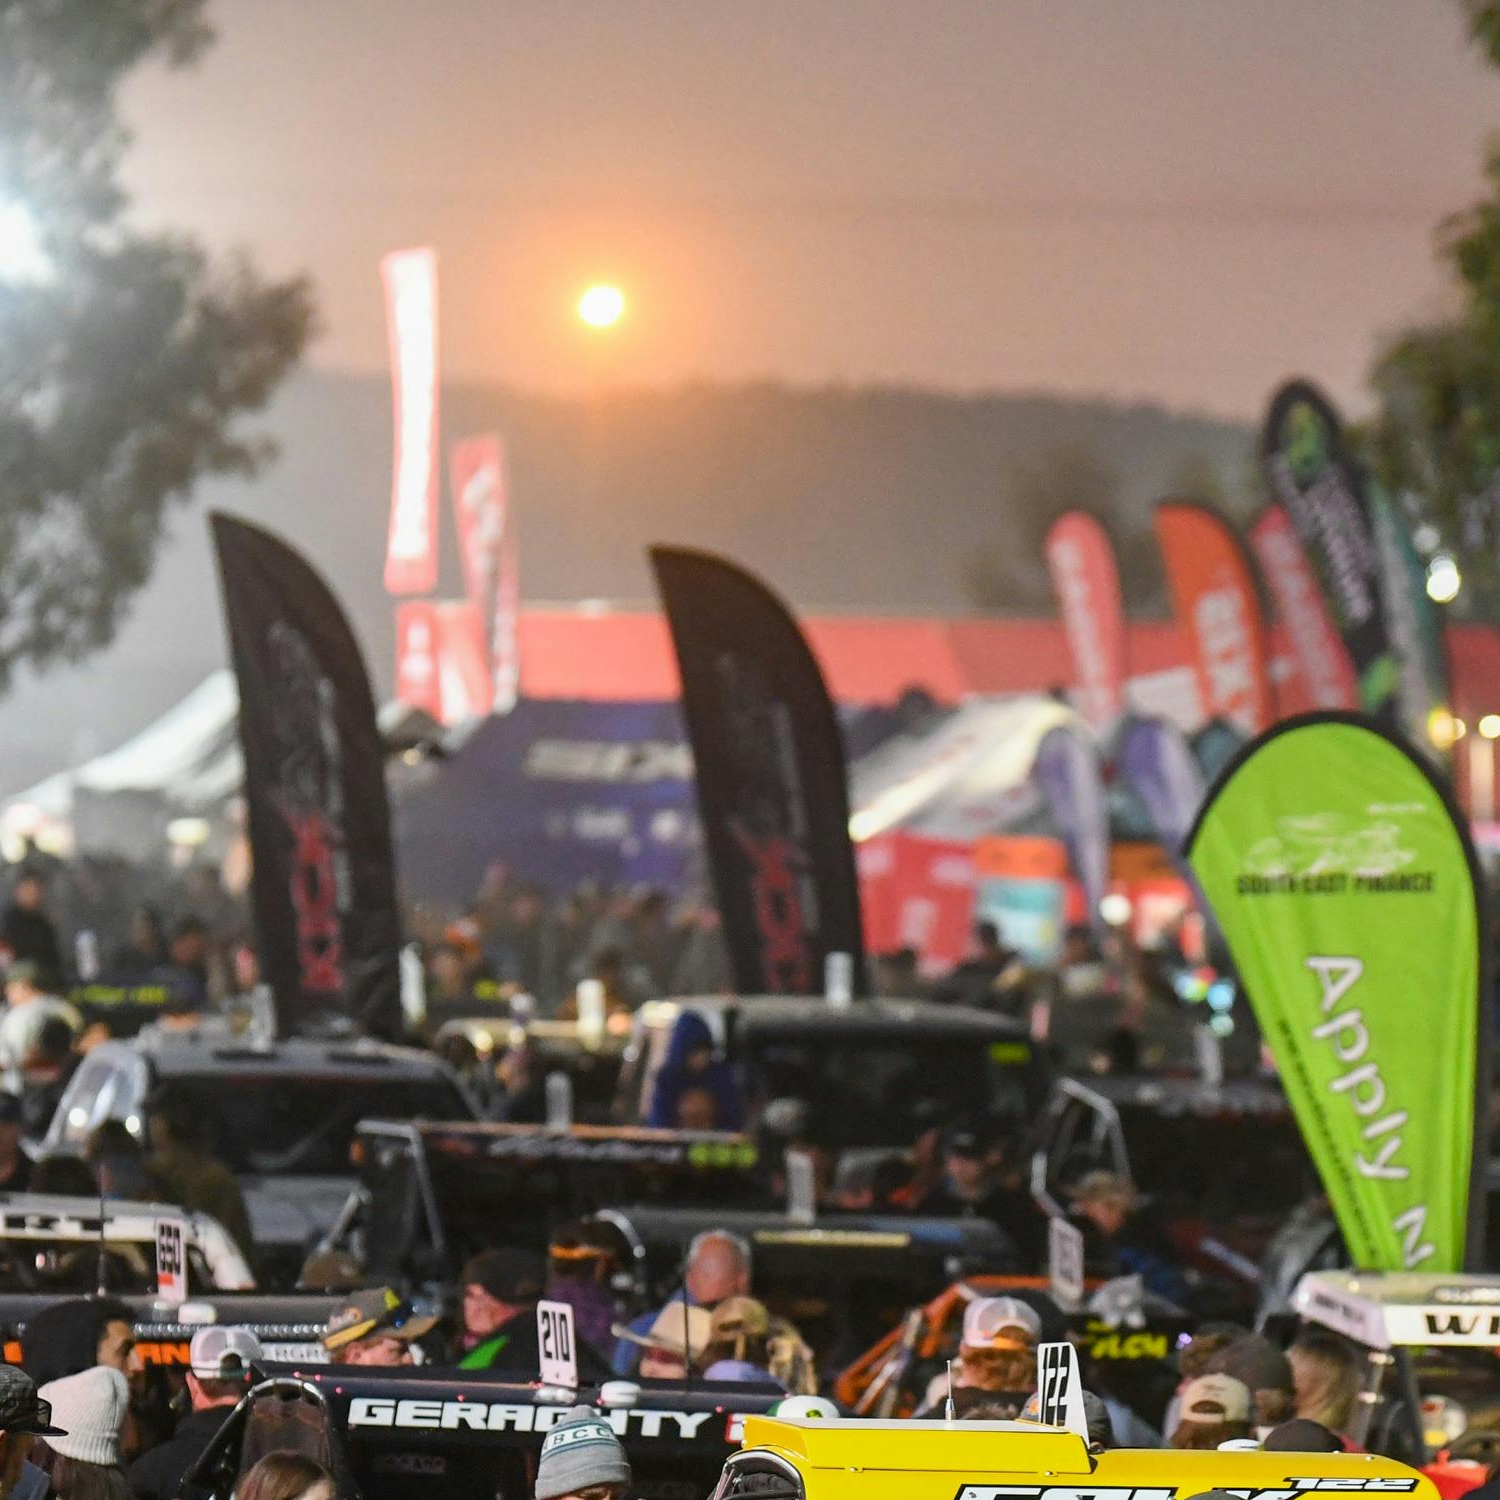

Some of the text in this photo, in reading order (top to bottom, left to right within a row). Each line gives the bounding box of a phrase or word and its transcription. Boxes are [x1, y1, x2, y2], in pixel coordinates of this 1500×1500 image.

[1306, 955, 1411, 1181] Apply
[542, 1311, 570, 1361] 210
[1041, 1346, 1071, 1426] 122
[1284, 1476, 1420, 1494] 122
